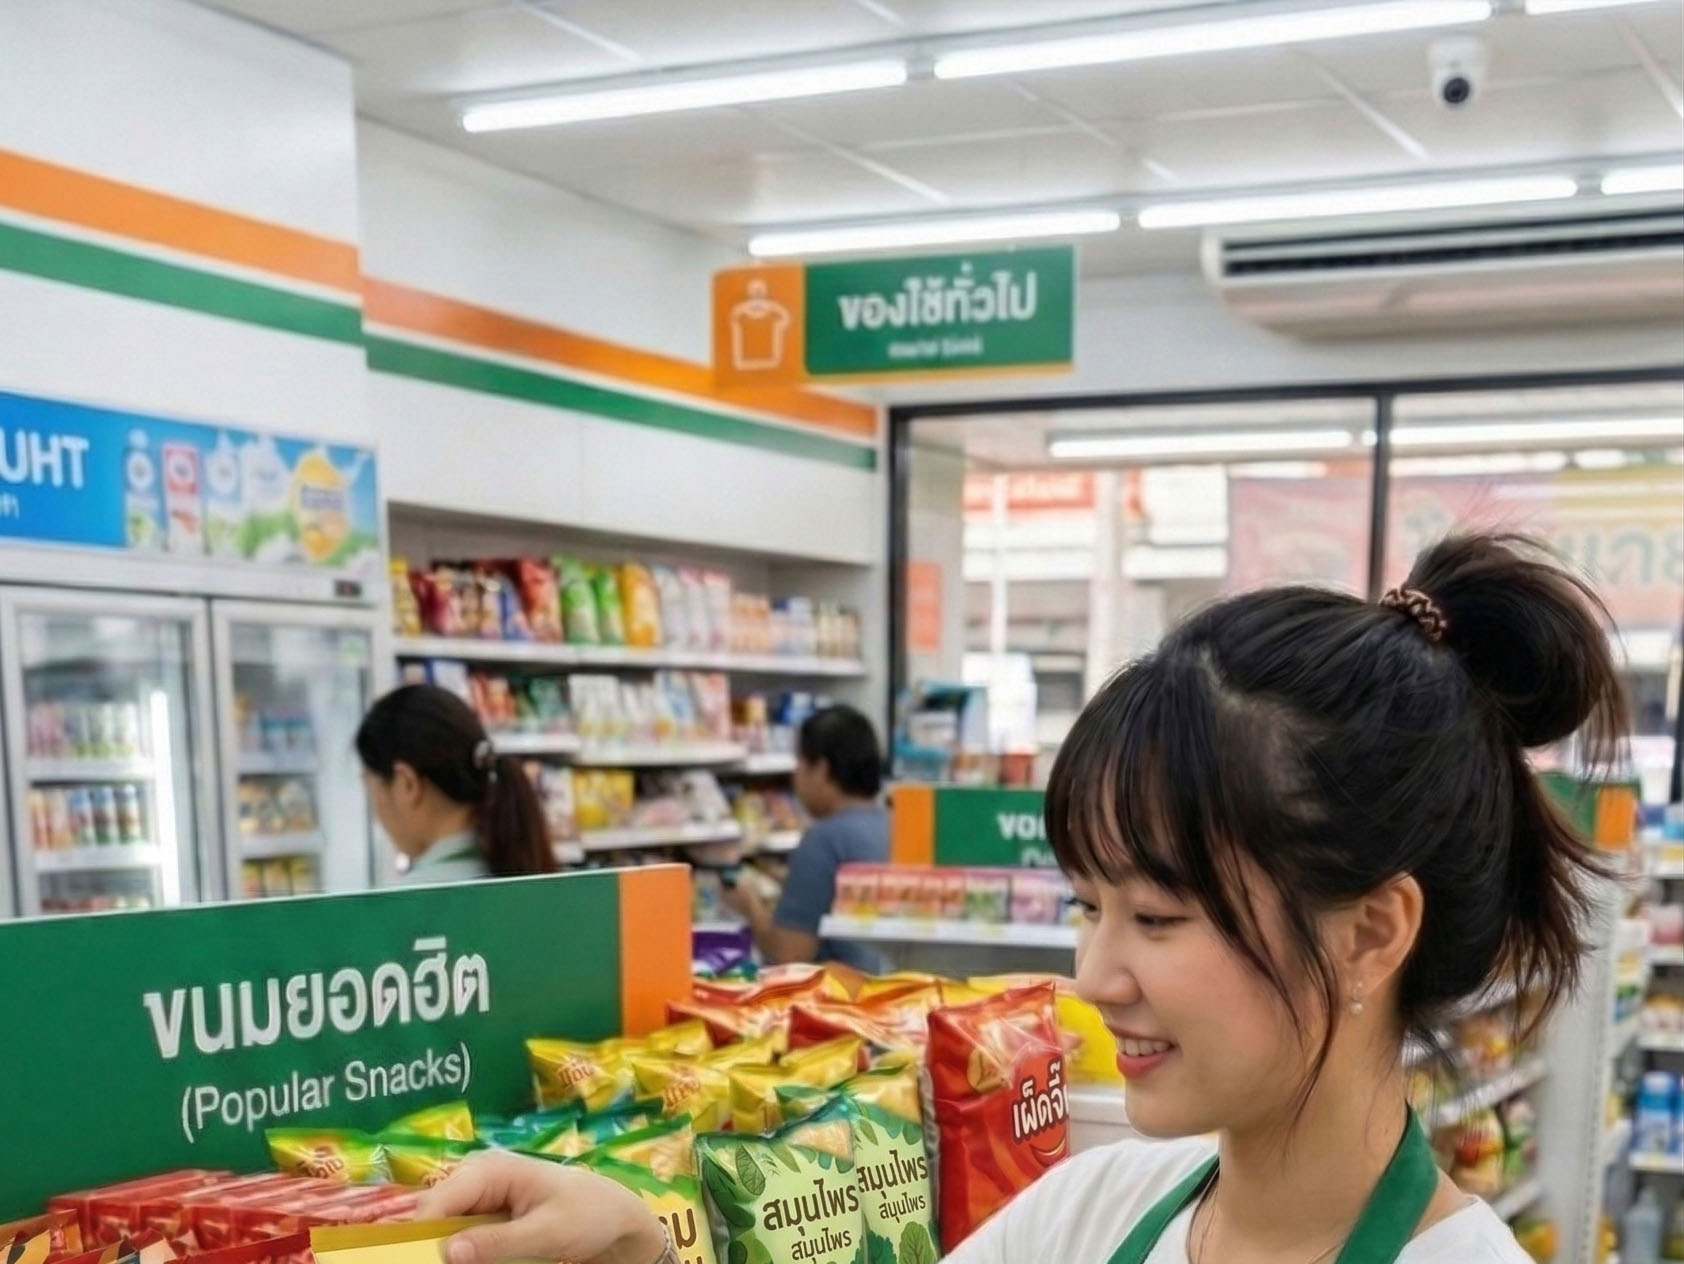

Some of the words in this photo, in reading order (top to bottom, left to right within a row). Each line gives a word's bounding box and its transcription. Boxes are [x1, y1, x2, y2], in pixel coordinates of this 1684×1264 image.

[0, 428, 90, 489] UHT
[143, 936, 491, 1059] ขนมยอดฮิต
[182, 1071, 334, 1142] (Popular
[345, 1041, 471, 1102] Snacks)
[856, 1149, 928, 1200] สมุนไพร
[762, 1178, 859, 1236] สมุนไพร
[878, 1191, 926, 1224] สมุนไพร
[791, 1227, 852, 1264] สมุนไพร
